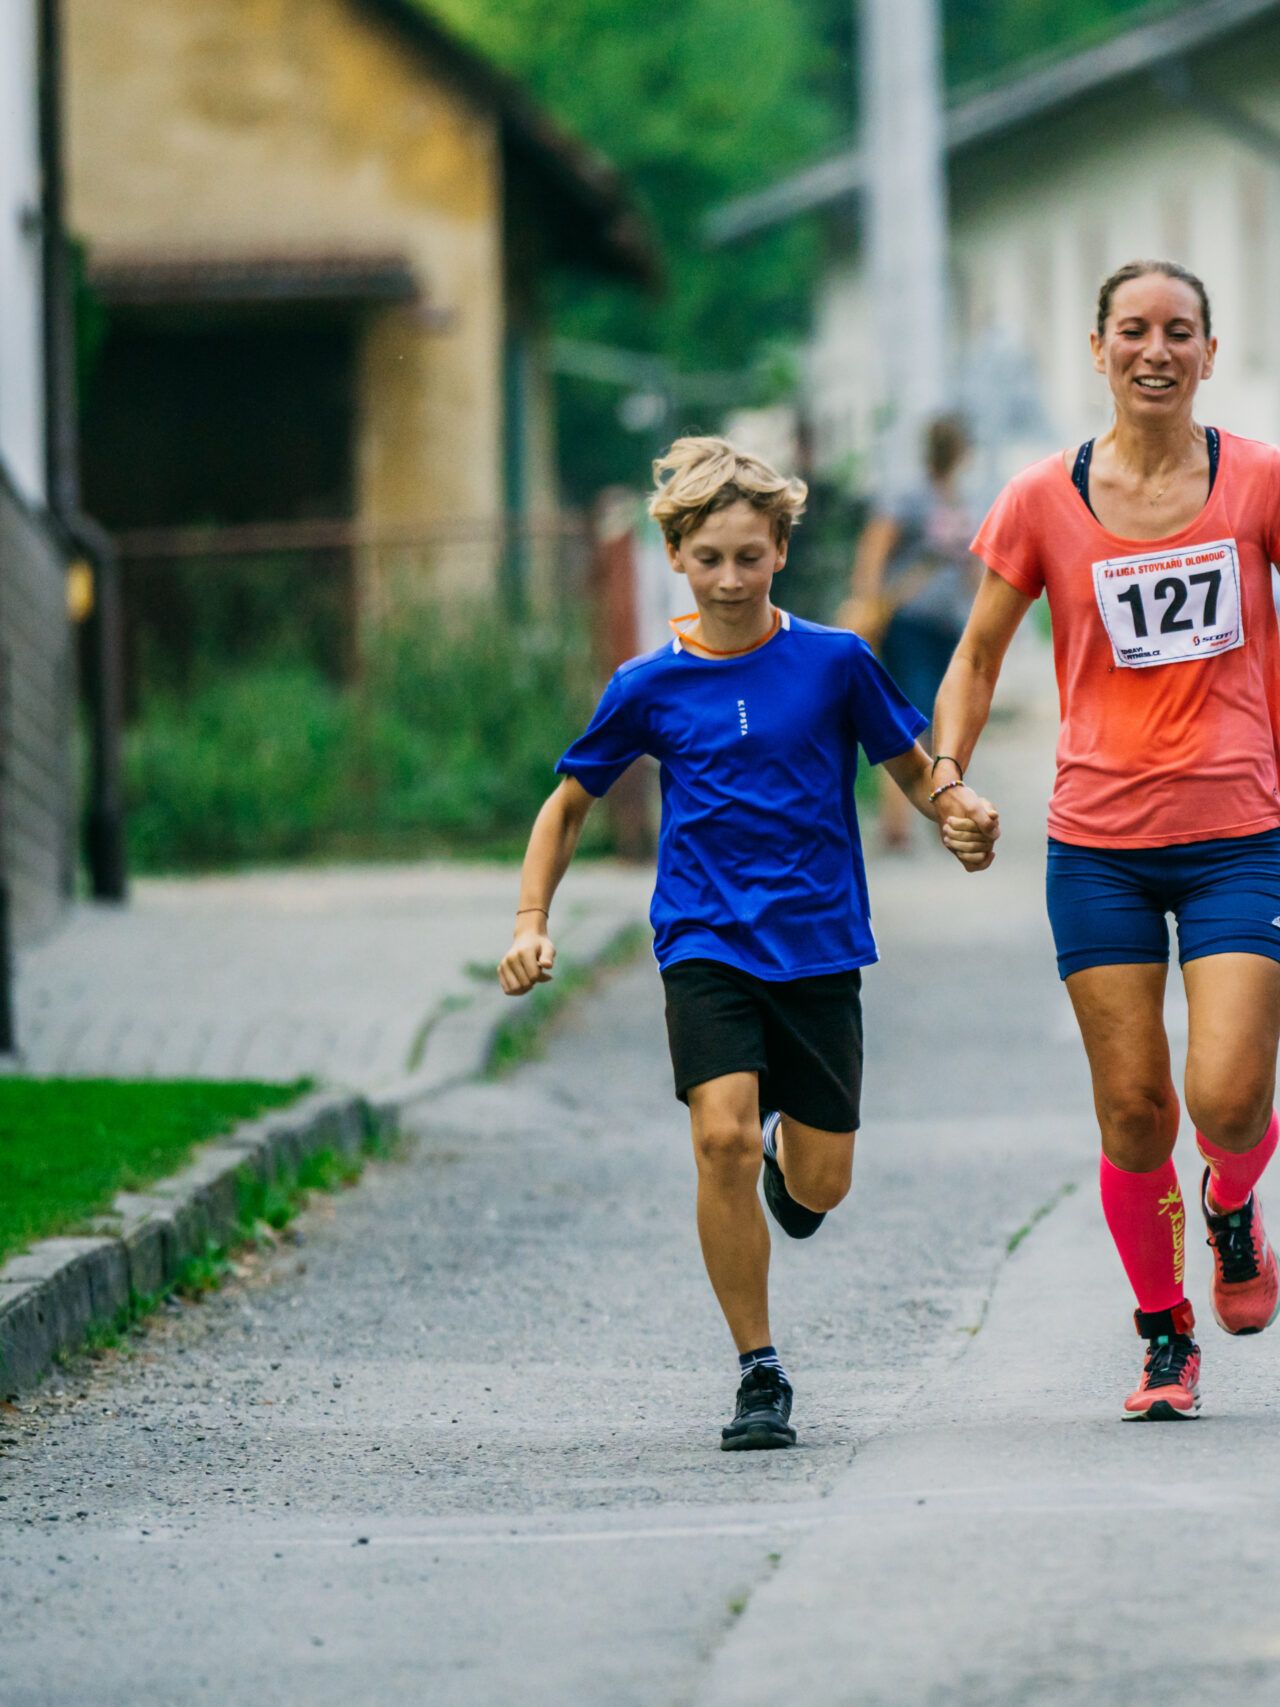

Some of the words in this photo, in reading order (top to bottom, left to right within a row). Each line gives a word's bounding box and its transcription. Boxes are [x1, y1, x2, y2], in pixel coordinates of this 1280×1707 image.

[1116, 566, 1135, 577] LIGA
[1138, 556, 1182, 574] STOVKAŘŮ
[1185, 550, 1226, 567] OLOMOUC
[1117, 569, 1222, 638] 127
[737, 699, 748, 736] KIPSTA
